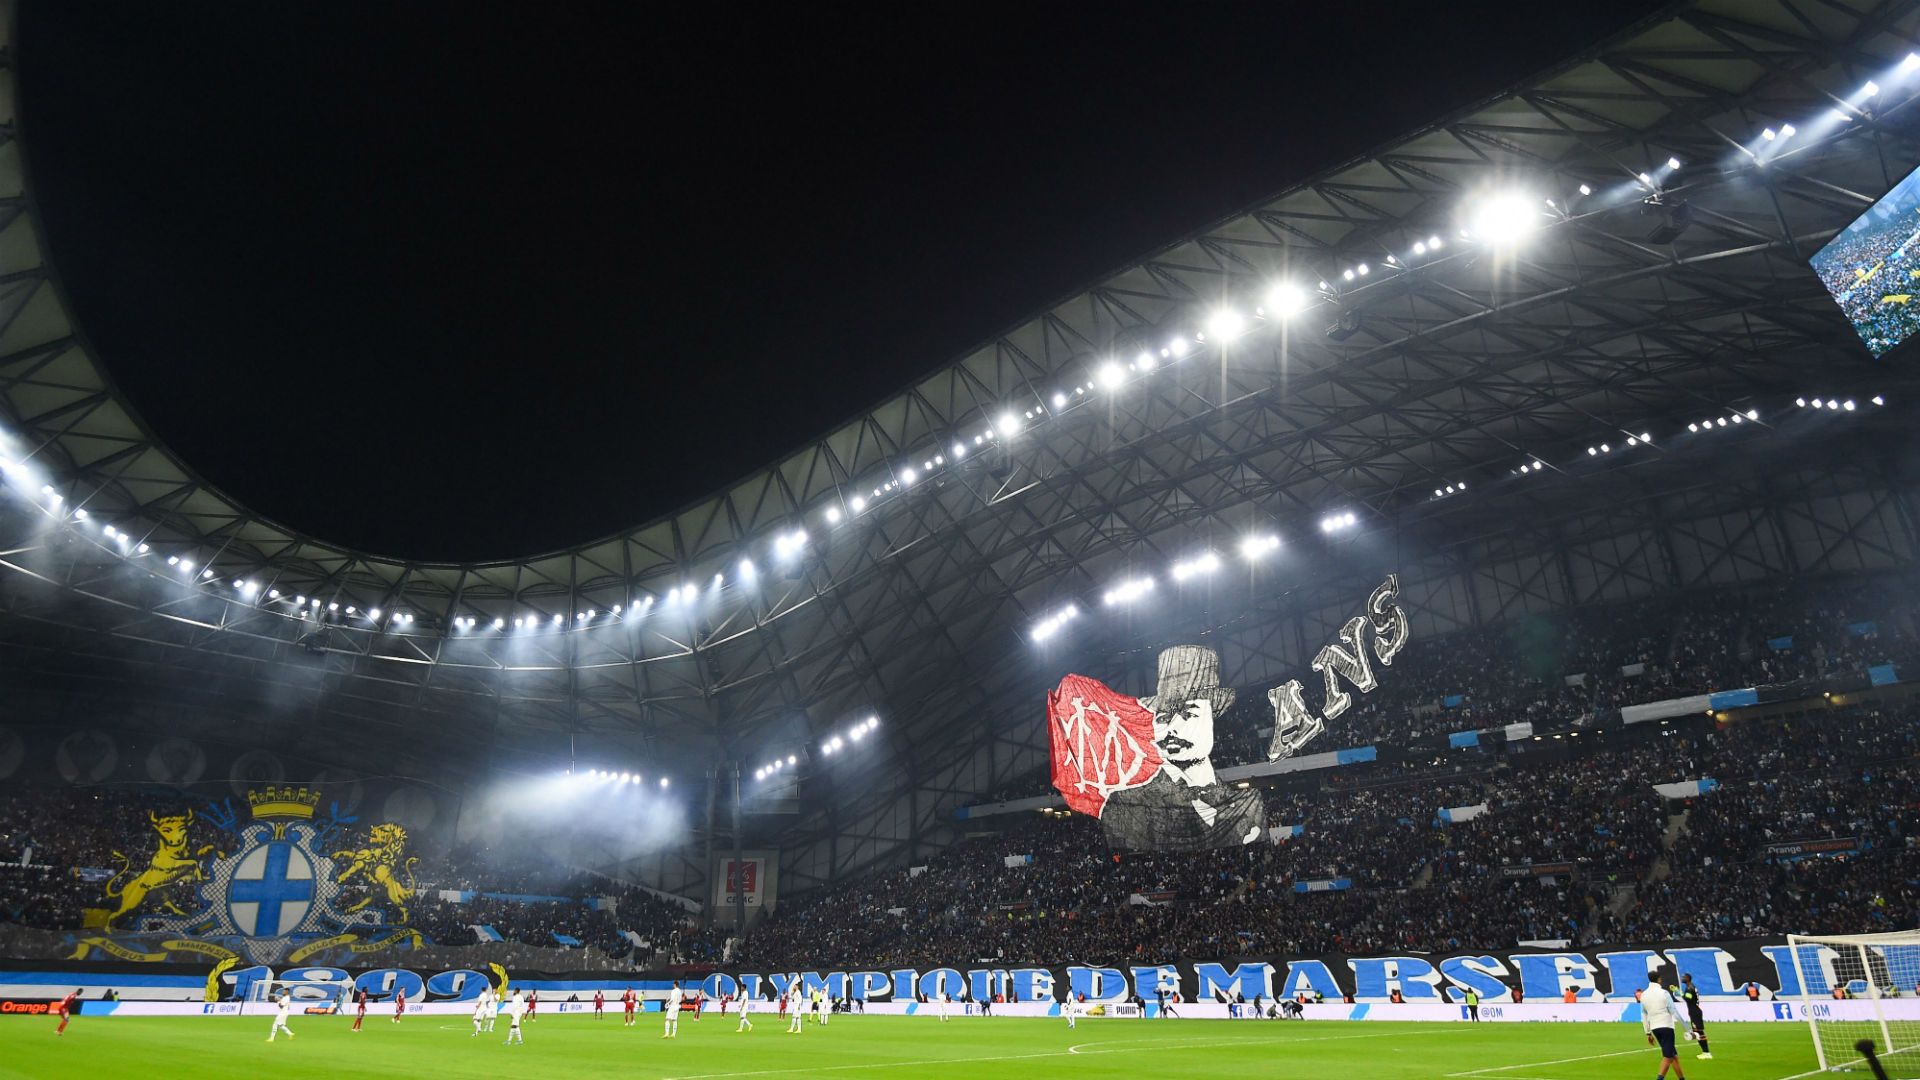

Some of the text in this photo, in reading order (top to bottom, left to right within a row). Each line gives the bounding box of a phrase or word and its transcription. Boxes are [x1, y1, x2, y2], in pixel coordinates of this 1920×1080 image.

[1267, 573, 1409, 765] ANS
[1768, 846, 1801, 854] Orange
[1503, 868, 1530, 876] Orange
[222, 965, 494, 1003] 1899
[702, 967, 1057, 1003] OLYMPIQUE
[1066, 966, 1184, 1003] DE
[2, 1002, 48, 1015] Orange
[1481, 1007, 1504, 1018] @OM
